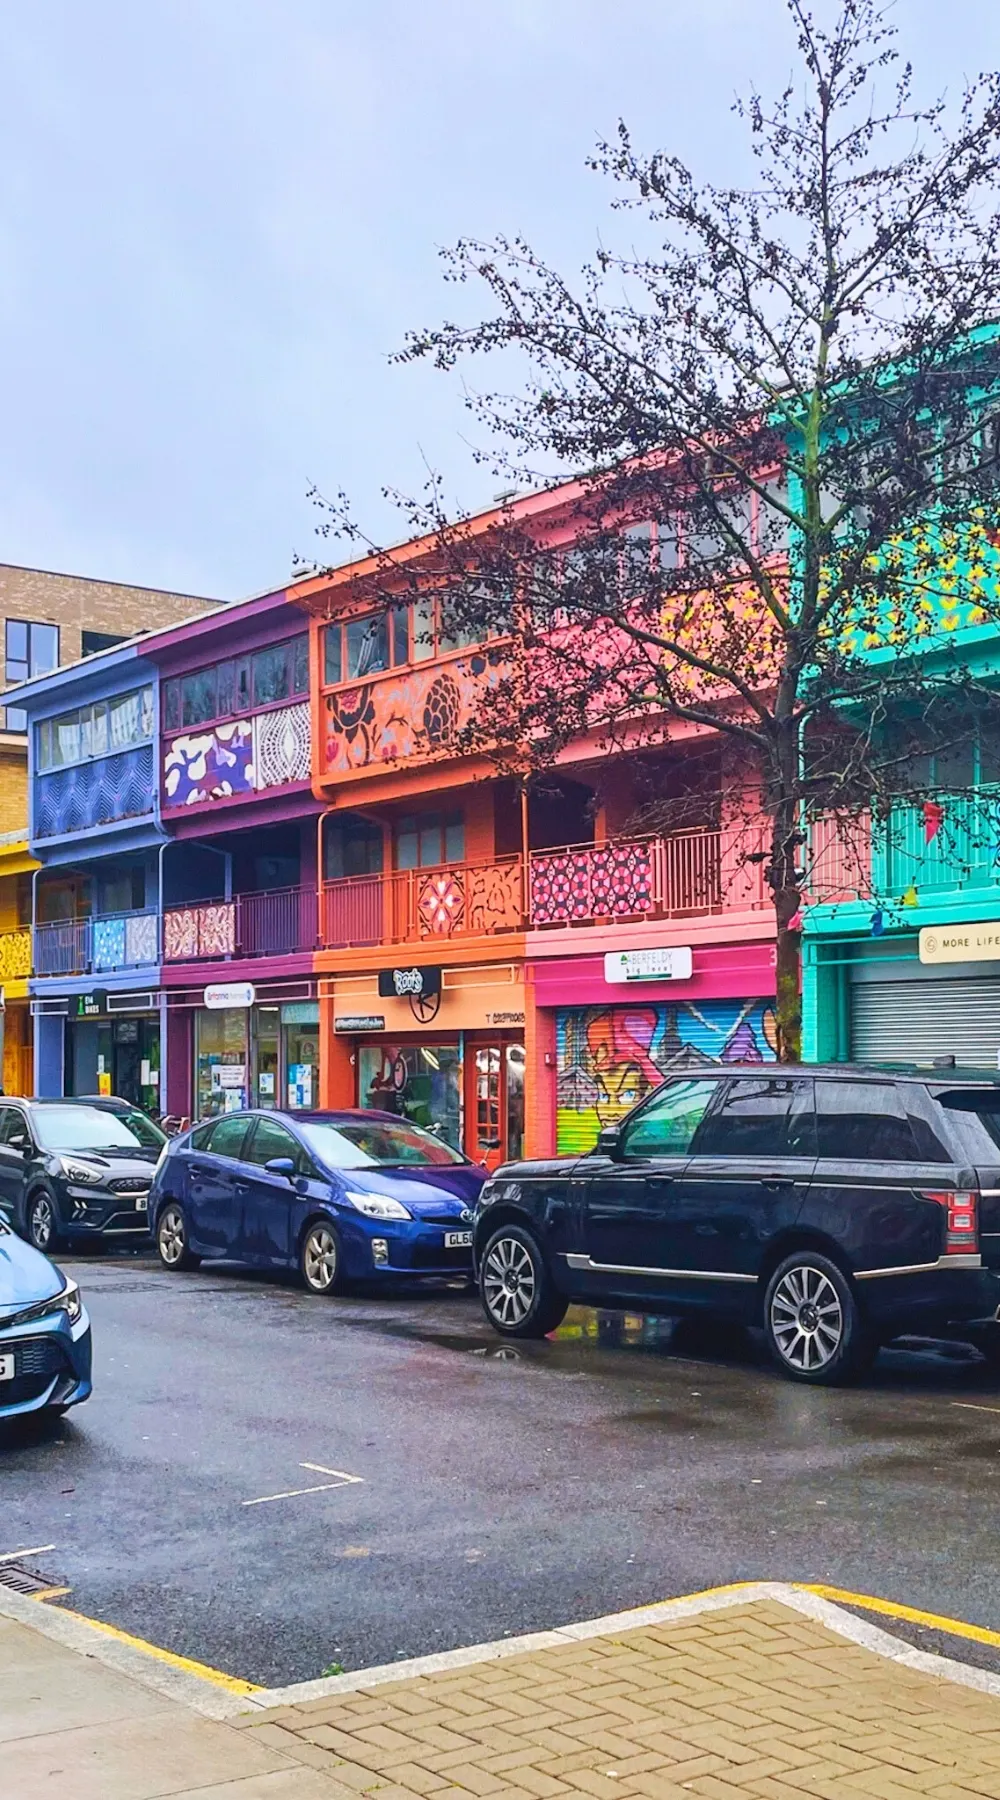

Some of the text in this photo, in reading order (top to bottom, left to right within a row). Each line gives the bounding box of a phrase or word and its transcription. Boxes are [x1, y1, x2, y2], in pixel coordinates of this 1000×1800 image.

[943, 936, 1000, 947] MORE LIFE
[626, 963, 673, 975] big local
[393, 968, 423, 995] Roots
